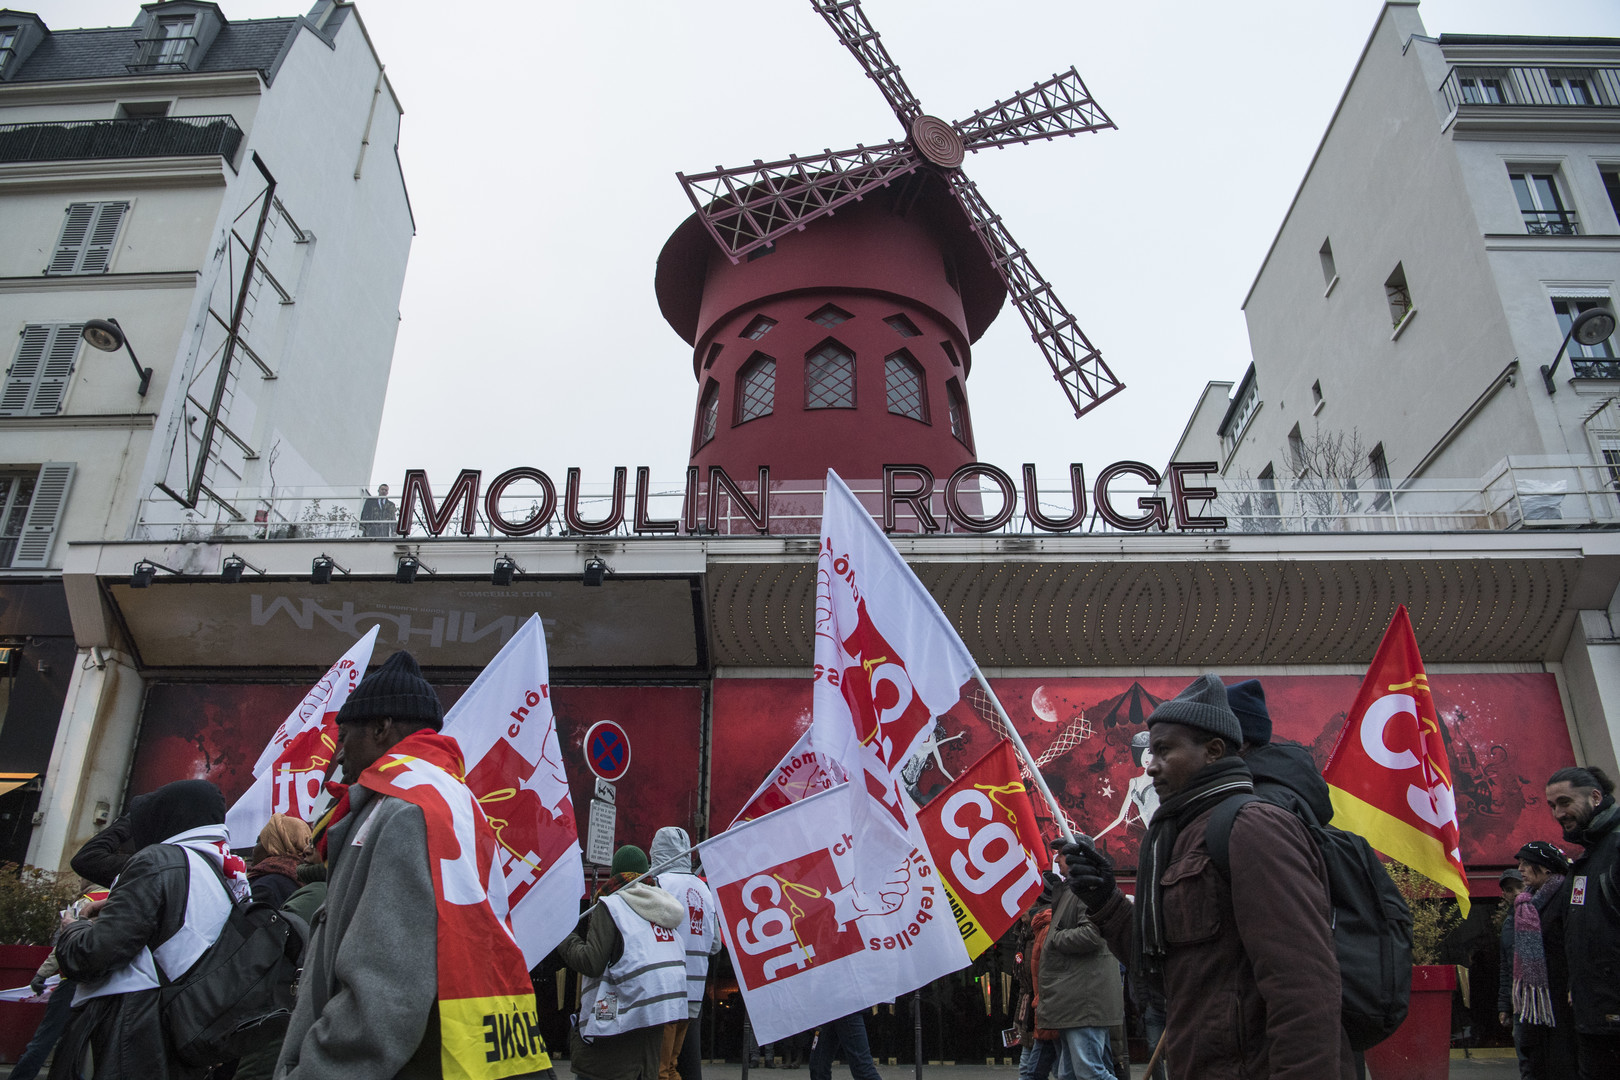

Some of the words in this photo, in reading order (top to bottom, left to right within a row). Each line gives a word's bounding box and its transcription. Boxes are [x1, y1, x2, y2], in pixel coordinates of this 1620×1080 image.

[397, 466, 770, 536] MOULIN
[883, 460, 1228, 532] ROUGE
[941, 789, 1042, 918] cgt
[737, 874, 816, 981] cgt
[870, 886, 934, 951] rebelles
